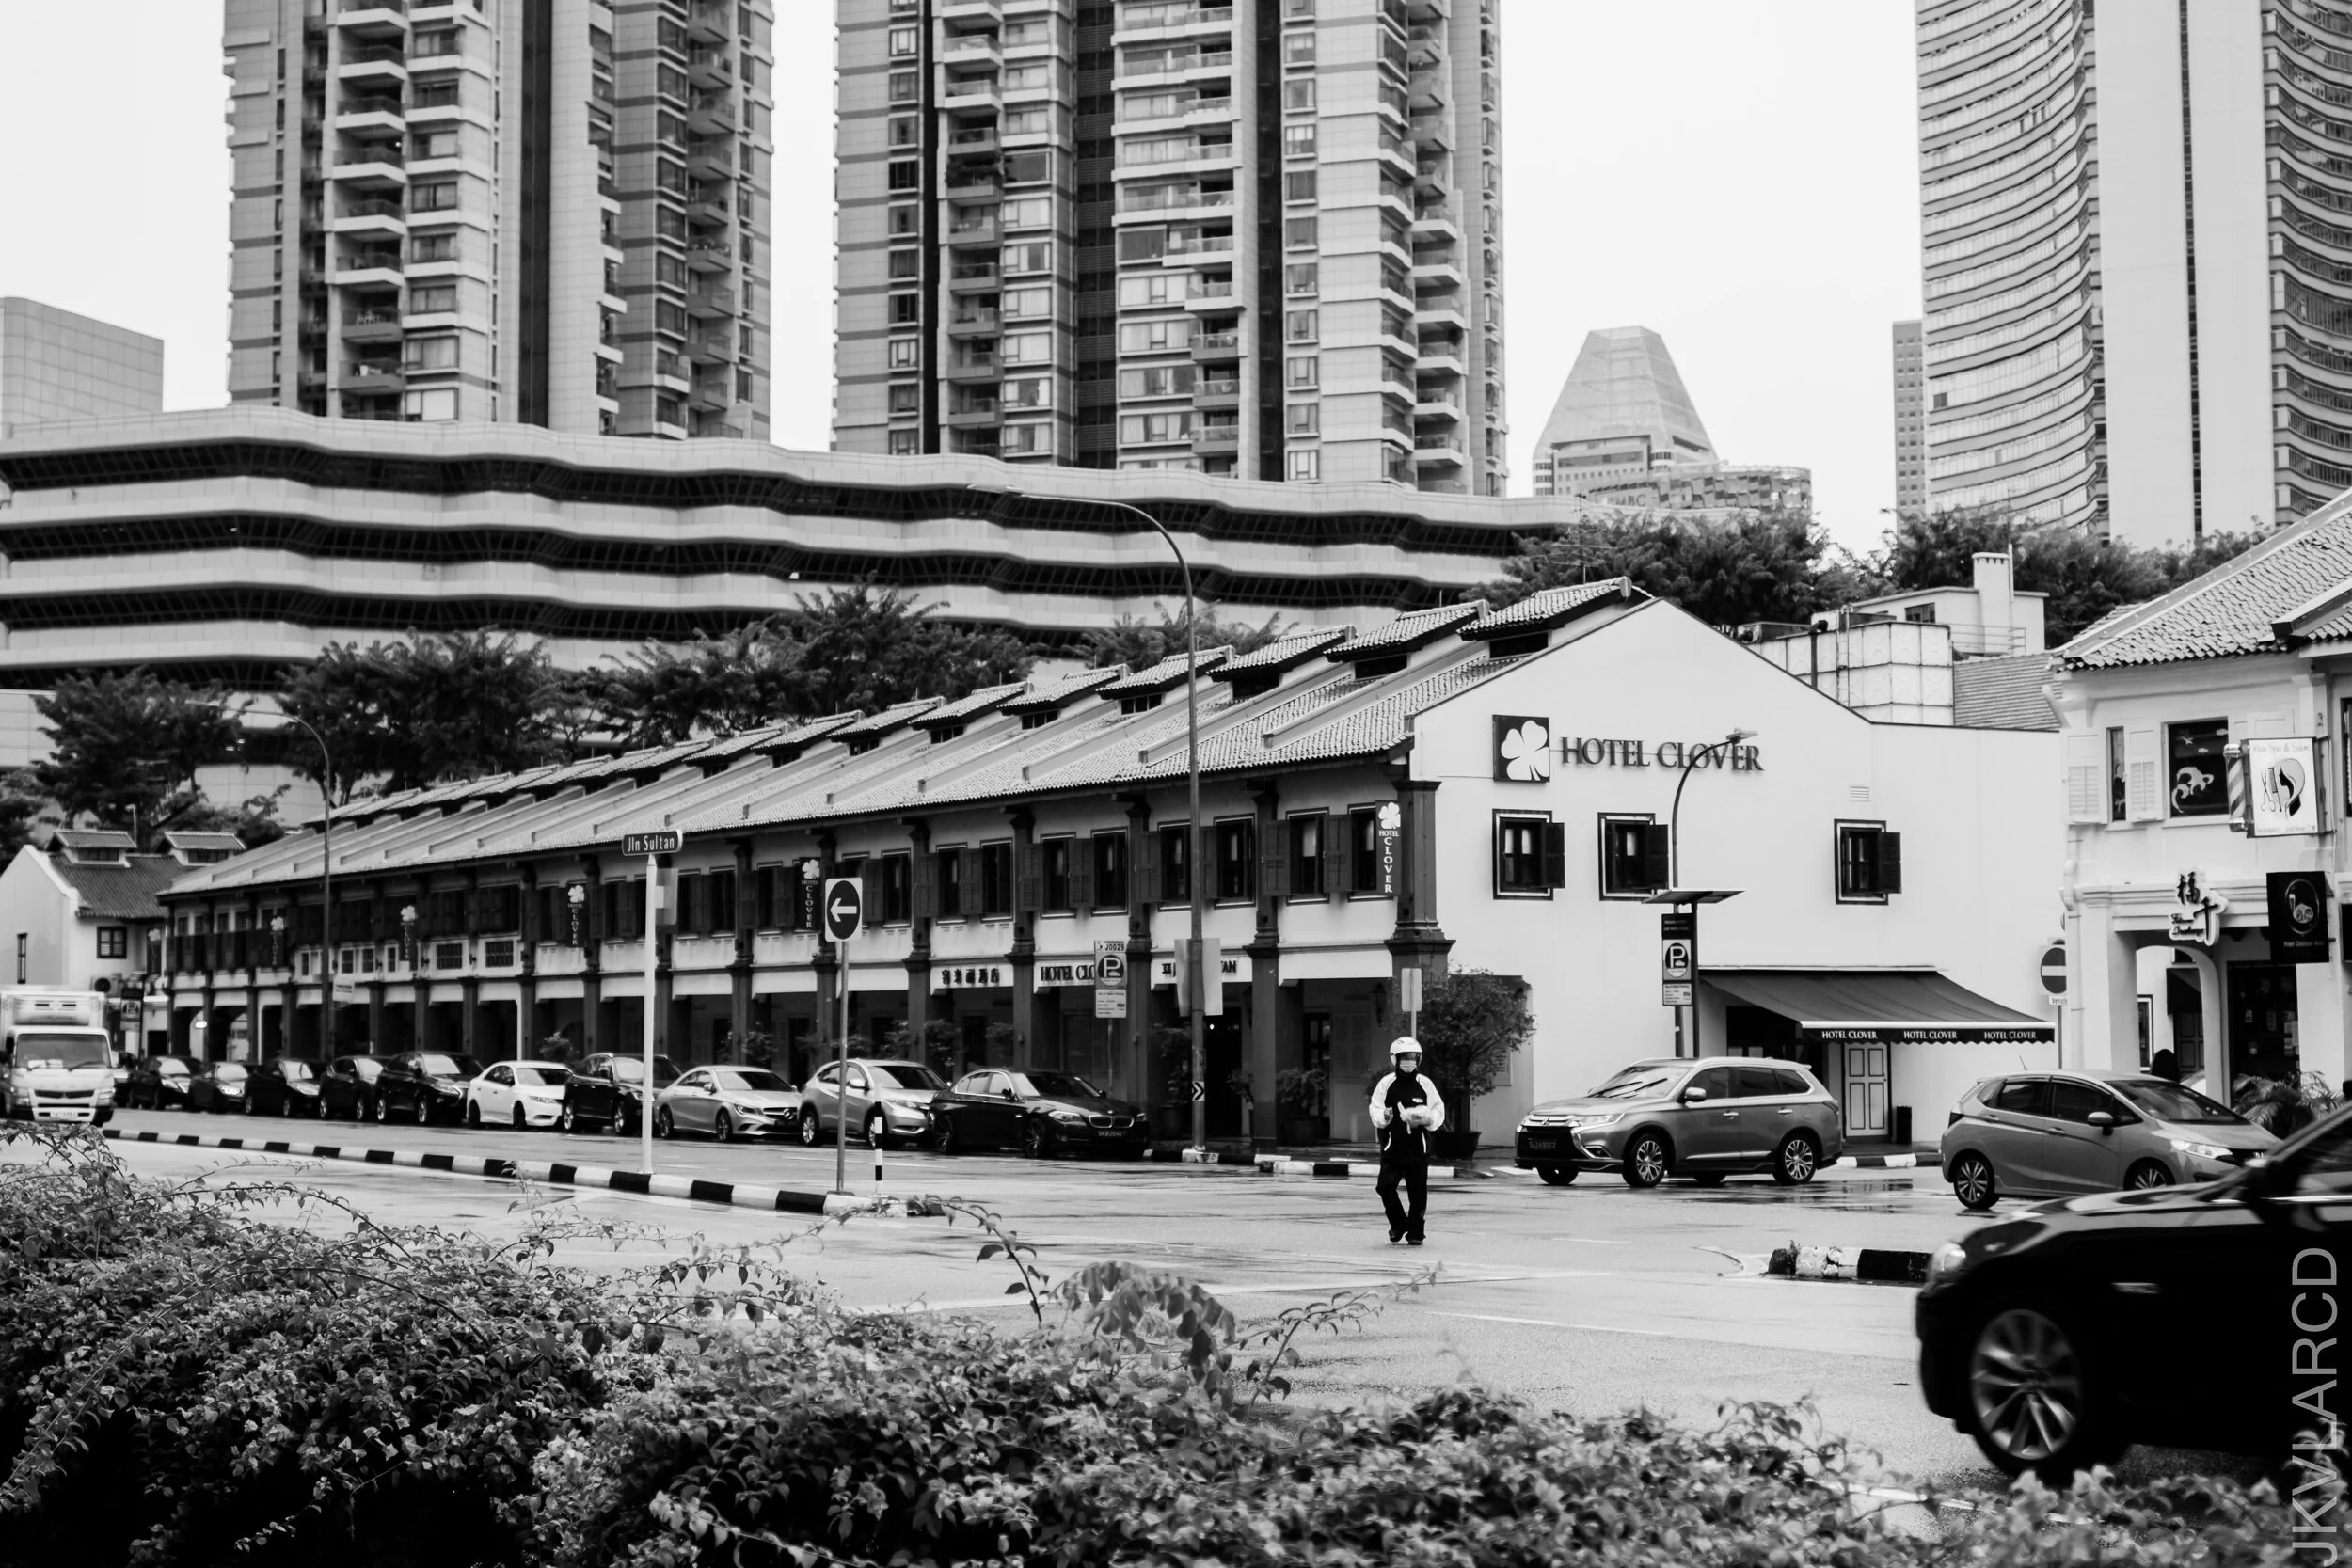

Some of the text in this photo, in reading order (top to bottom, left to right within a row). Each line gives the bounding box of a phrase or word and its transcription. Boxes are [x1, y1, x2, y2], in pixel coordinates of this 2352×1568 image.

[1560, 736, 1764, 771] HOTEL CLOVER
[627, 834, 675, 852] Jln Sultan
[1383, 837, 1393, 893] CLOVER
[805, 885, 814, 928] CLOVER
[1040, 965, 1073, 981] HOTEL
[1821, 1030, 1878, 1039] HOTEL CLOVER
[1903, 1030, 1957, 1039] HOTEL CLOVER
[1984, 1031, 2036, 1039] HOTEL CLOVER
